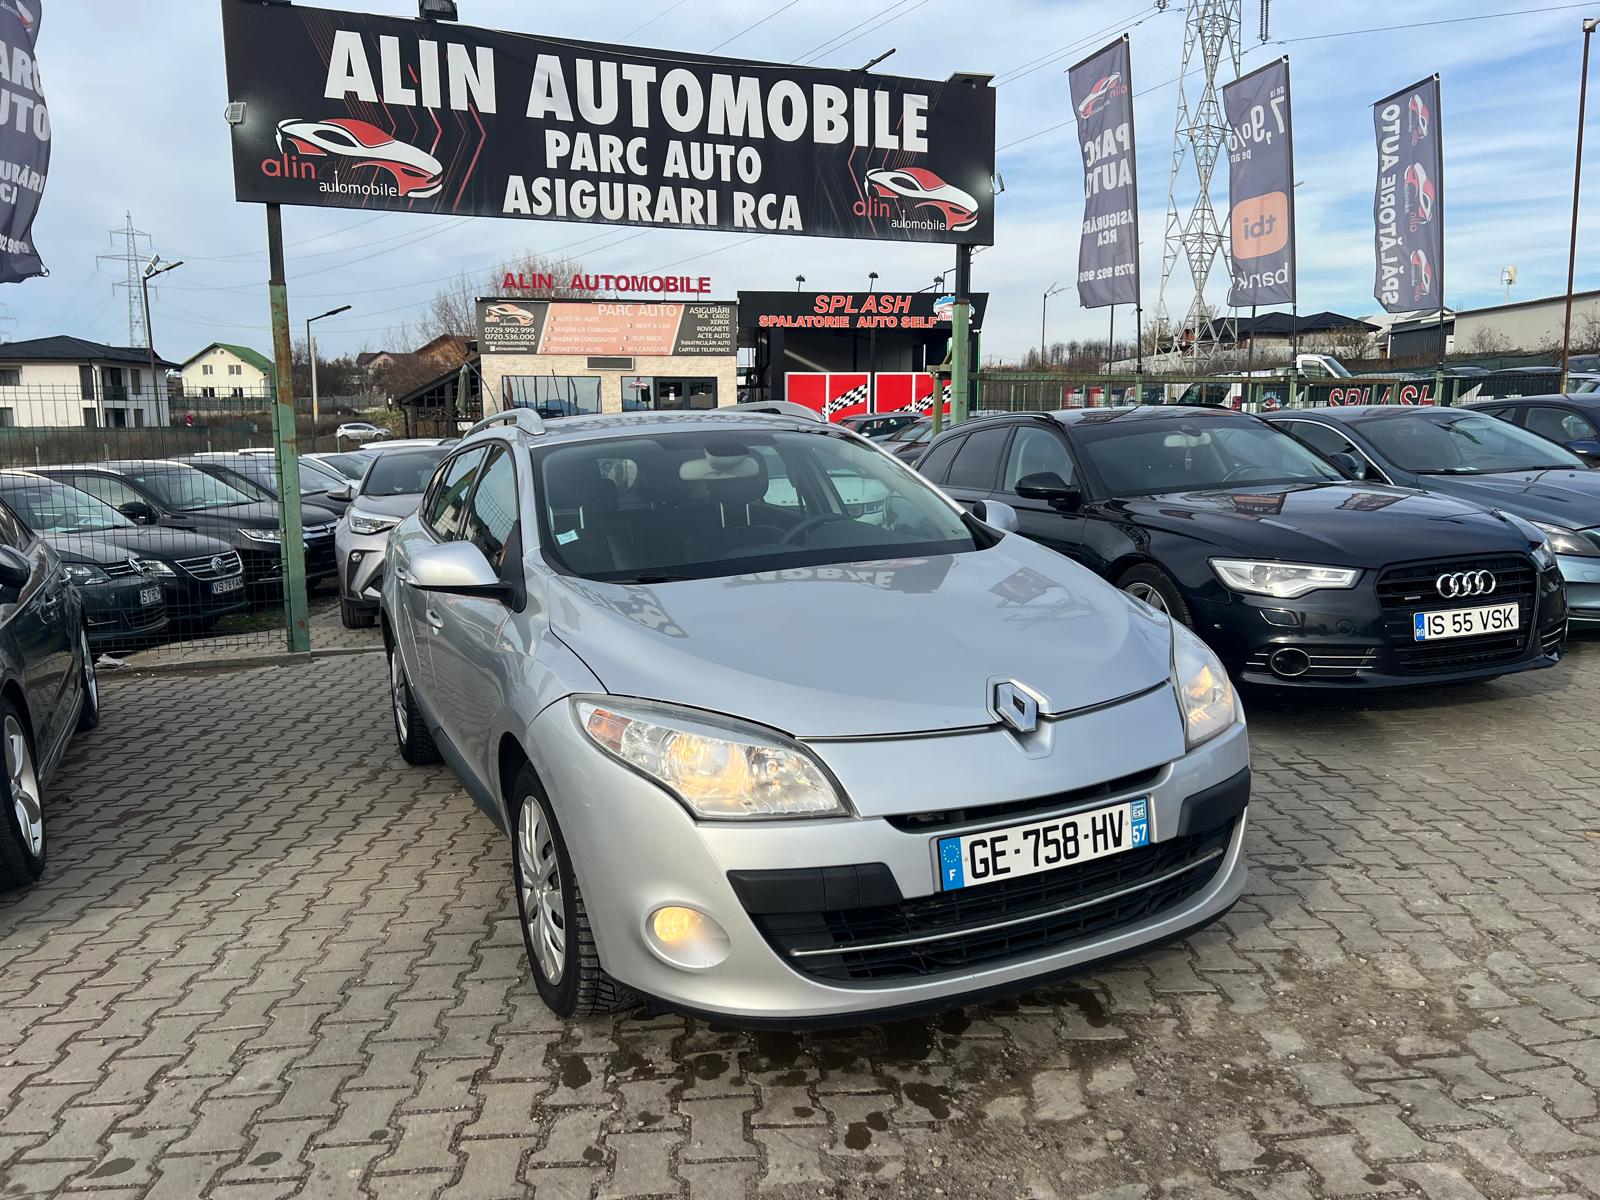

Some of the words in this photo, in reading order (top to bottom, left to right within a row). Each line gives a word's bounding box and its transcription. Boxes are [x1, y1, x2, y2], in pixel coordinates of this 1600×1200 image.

[324, 30, 497, 114] ALIN
[525, 54, 929, 153] AUTOMOBILE
[261, 153, 317, 180] alin
[545, 129, 648, 176] PARC
[663, 140, 762, 184] AUTO
[319, 170, 398, 197] automobile
[502, 174, 718, 225] ASIGURARI
[733, 191, 803, 231] RCA
[853, 196, 891, 218] alin
[891, 208, 946, 231] automobile
[503, 273, 552, 289] ALIN
[571, 274, 711, 294] AUTOMOBILE
[598, 304, 633, 316] PARC
[638, 305, 676, 317] AUTO
[689, 305, 729, 314] ASIGURĂRI
[813, 295, 912, 314] SPLASH
[759, 315, 849, 328] SPALATORIE
[857, 316, 897, 328] AUTO
[900, 317, 937, 328] SELF
[1428, 616, 1445, 636] IS
[1452, 612, 1473, 633] 55
[1480, 607, 1514, 630] VSK
[1416, 628, 1425, 637] RO
[1132, 823, 1147, 843] 57
[949, 868, 956, 881] F
